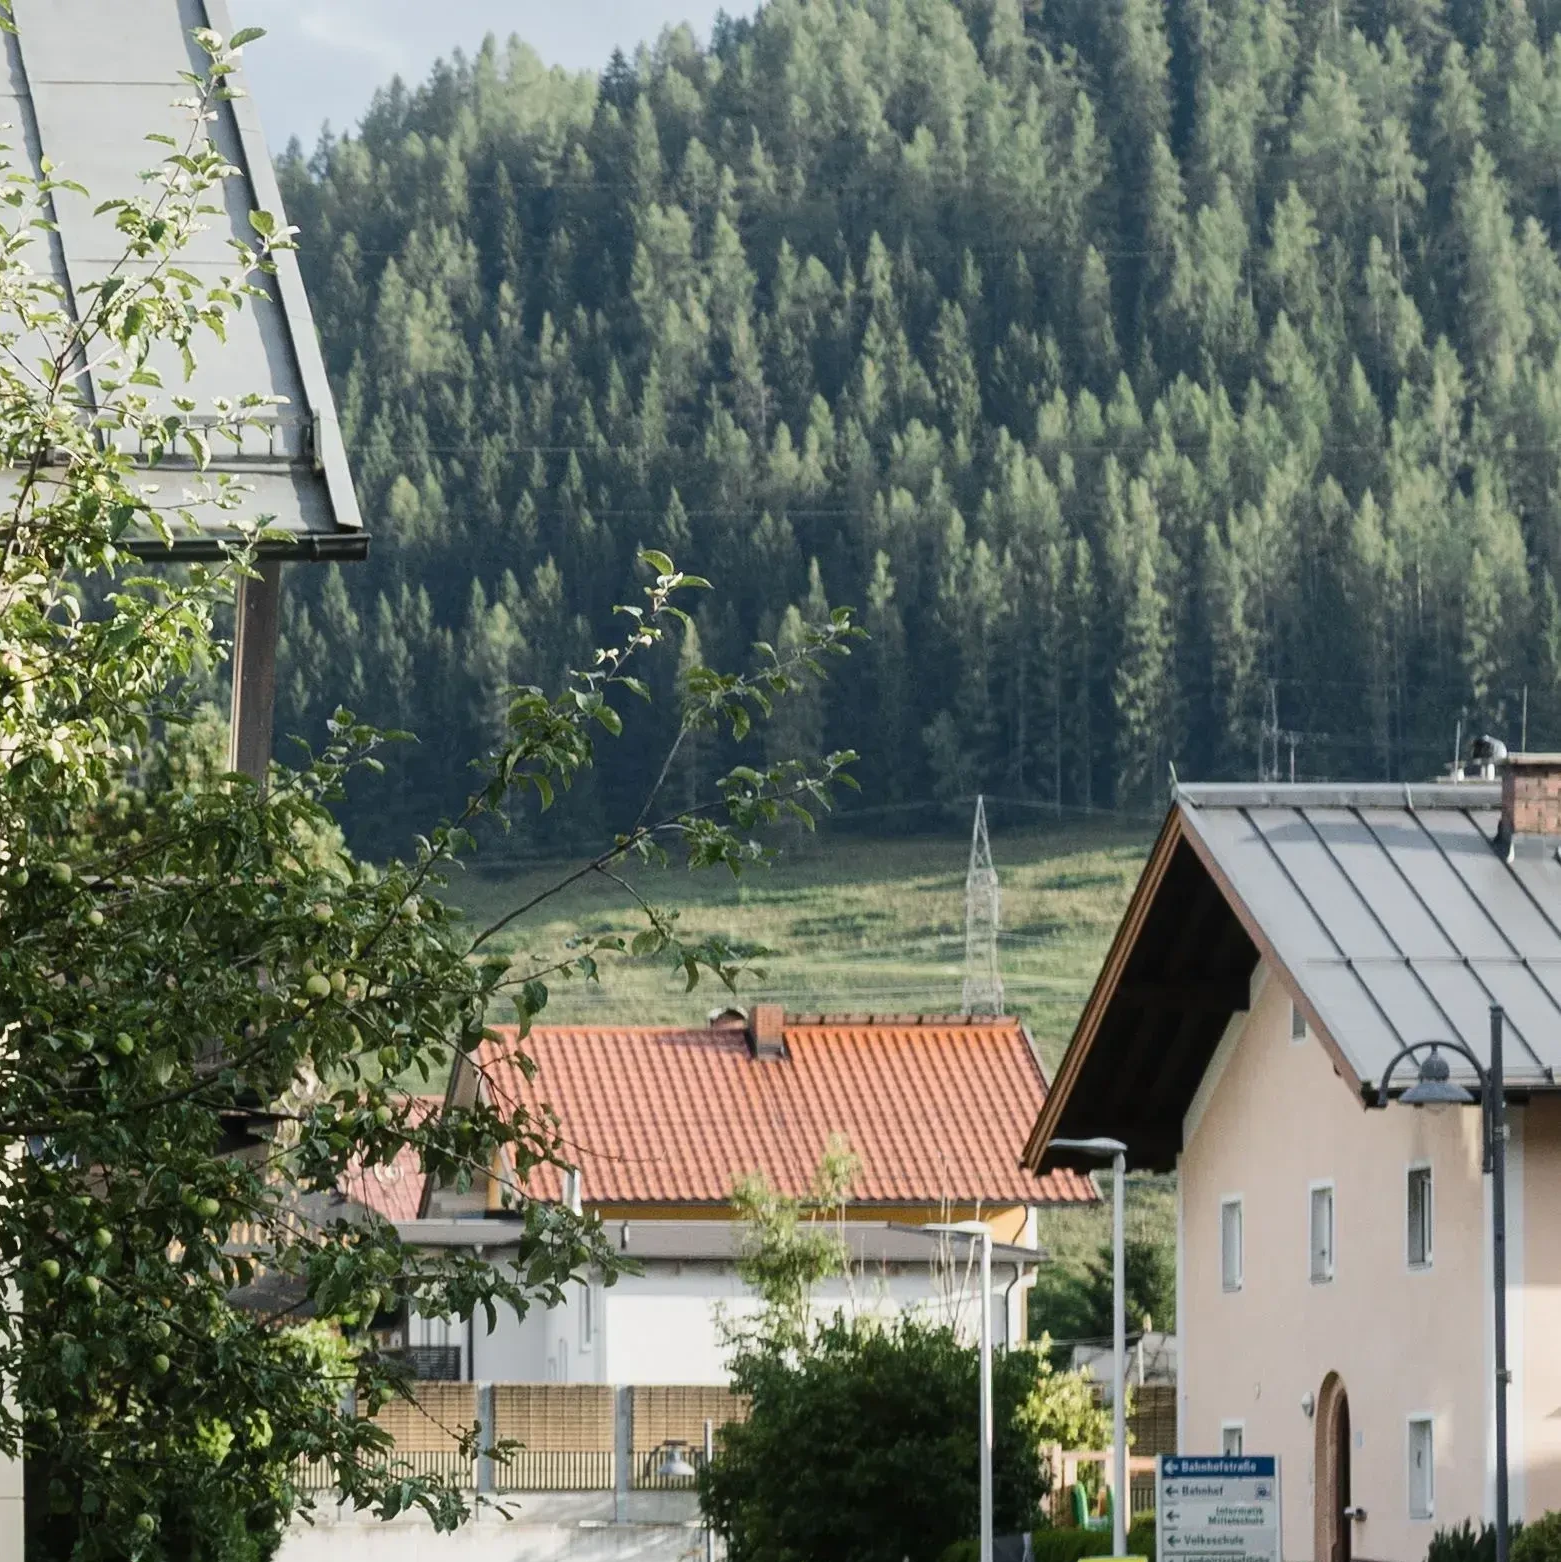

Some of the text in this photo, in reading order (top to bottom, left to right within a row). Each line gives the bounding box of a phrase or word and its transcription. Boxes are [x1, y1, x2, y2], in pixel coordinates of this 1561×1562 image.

[1181, 1460, 1257, 1473] Bahnhofstraße
[1182, 1485, 1223, 1497] Bahnhof
[1184, 1535, 1244, 1545] Volksschule
